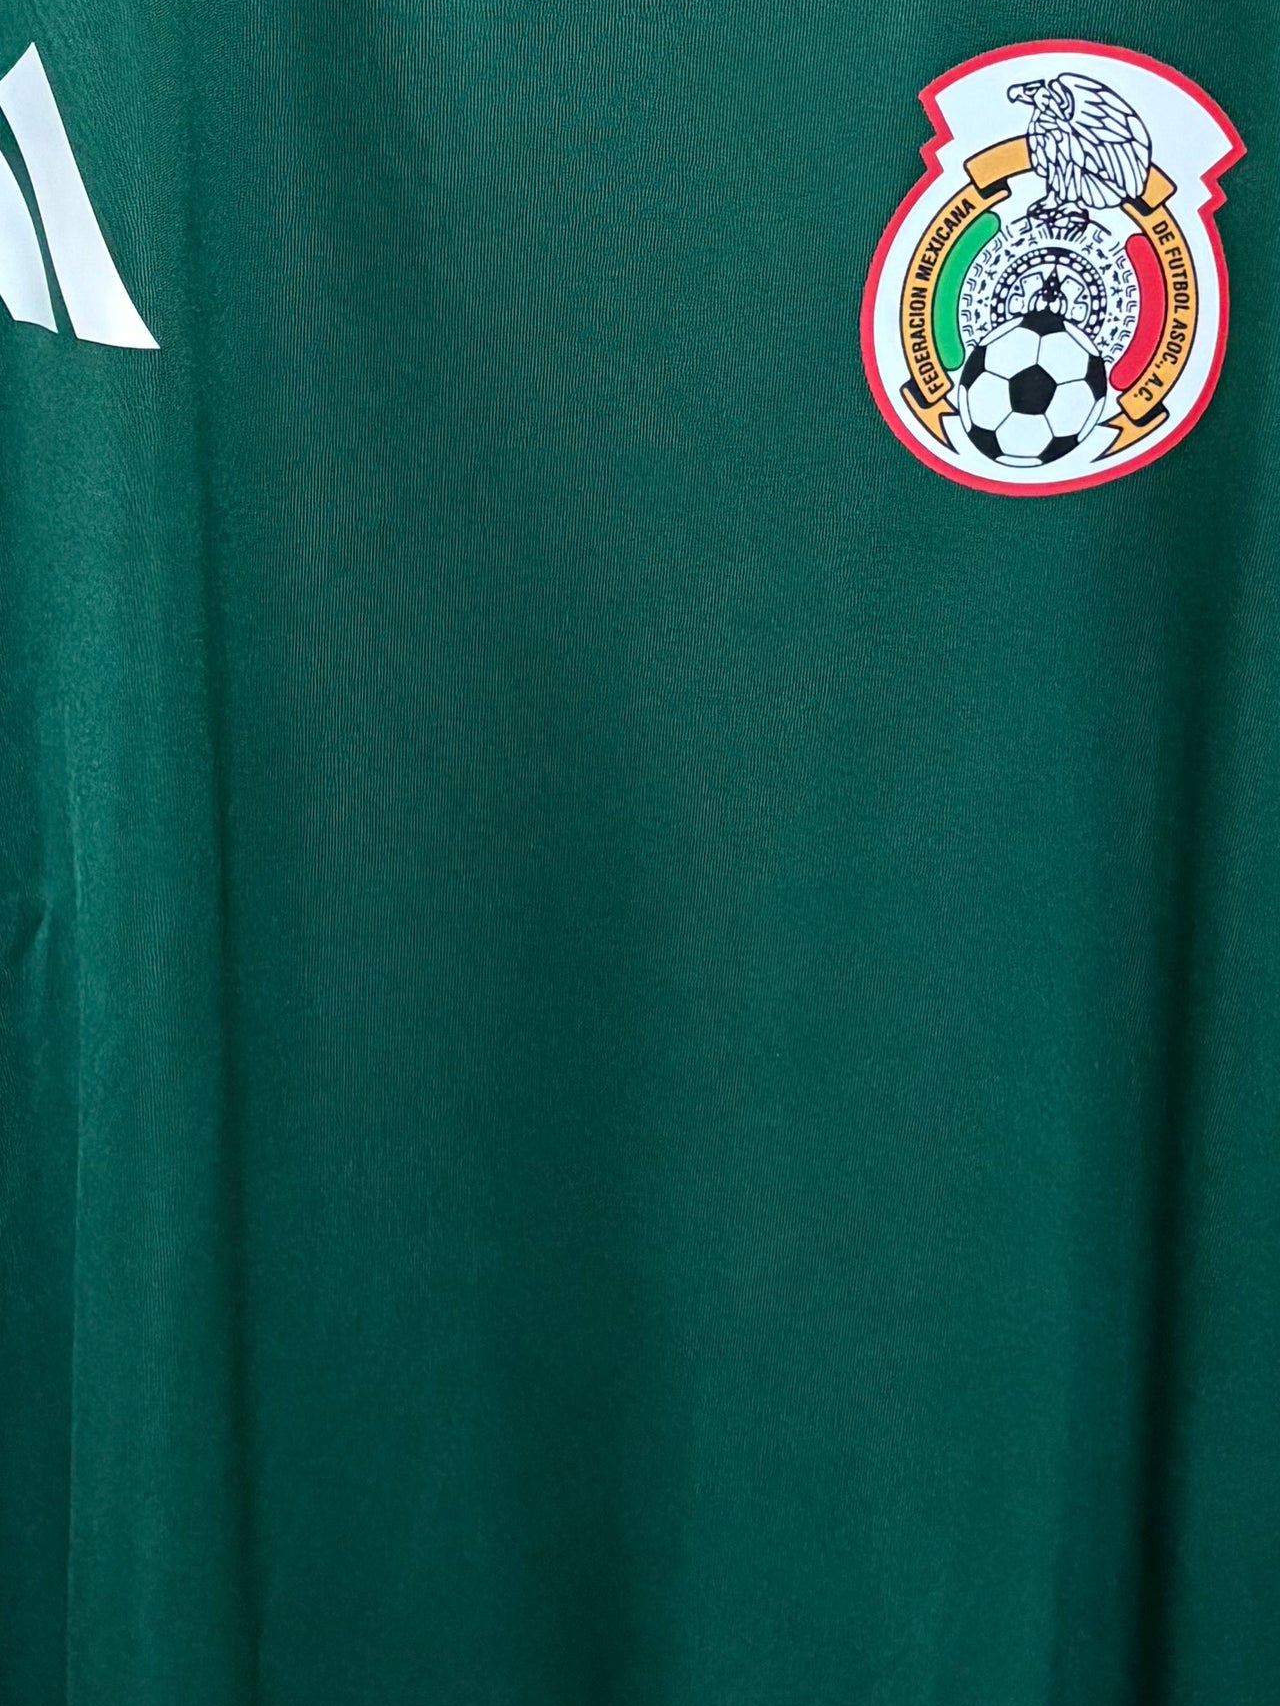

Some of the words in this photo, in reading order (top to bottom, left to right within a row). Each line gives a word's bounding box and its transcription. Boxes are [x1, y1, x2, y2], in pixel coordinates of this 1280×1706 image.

[915, 198, 977, 282] MEXICANA
[1151, 220, 1176, 246] DE
[1164, 246, 1191, 314] FUTBOL
[908, 286, 945, 395] FEDERACION
[1133, 372, 1164, 402] A.C.
